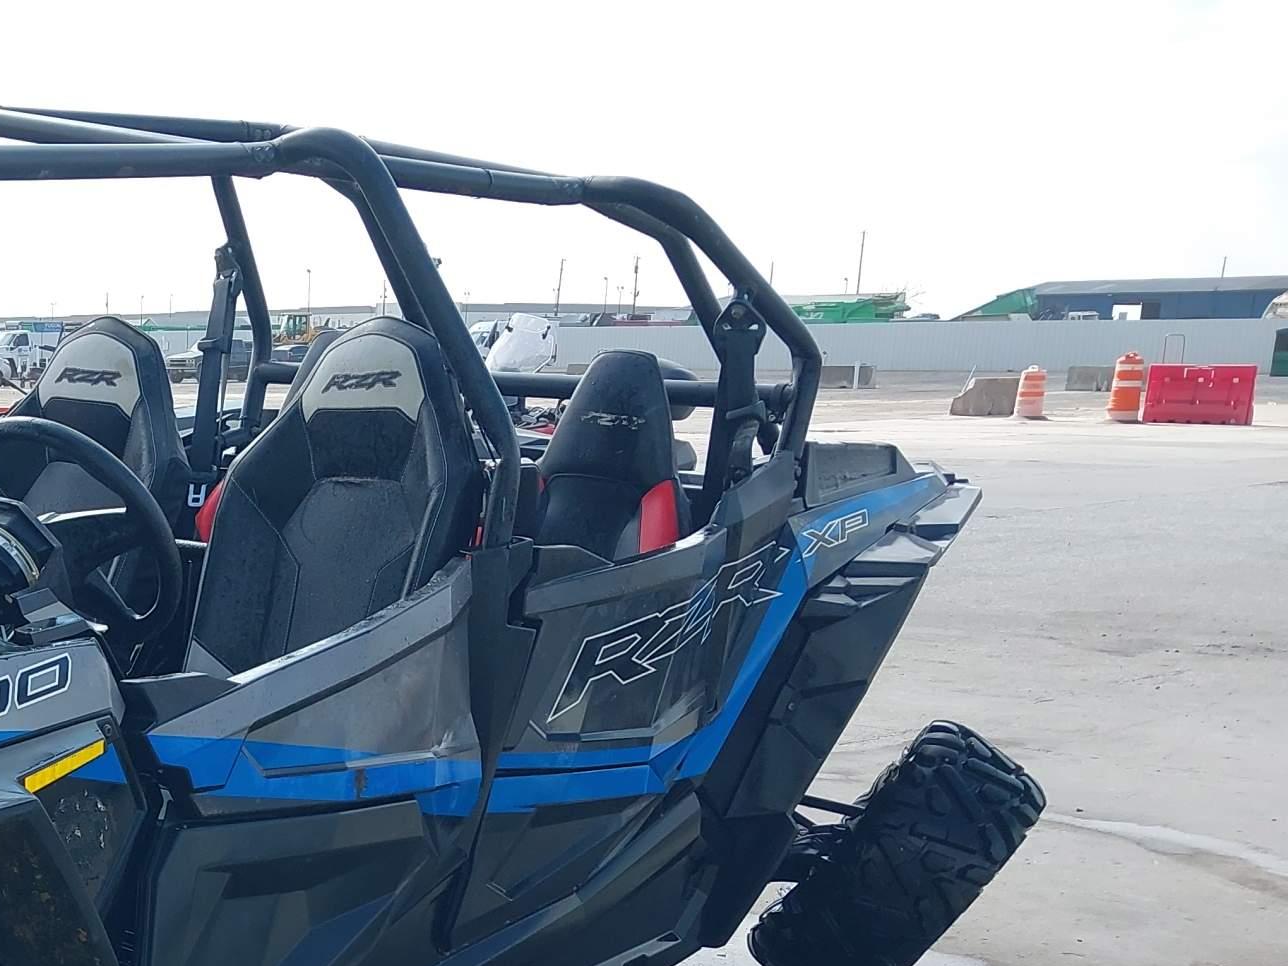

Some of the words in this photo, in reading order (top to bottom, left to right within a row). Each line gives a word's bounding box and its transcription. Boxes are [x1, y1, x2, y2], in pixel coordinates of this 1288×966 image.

[54, 366, 122, 387] RZR
[321, 370, 402, 394] RZR
[798, 508, 869, 559] XP
[546, 540, 791, 724] RZR
